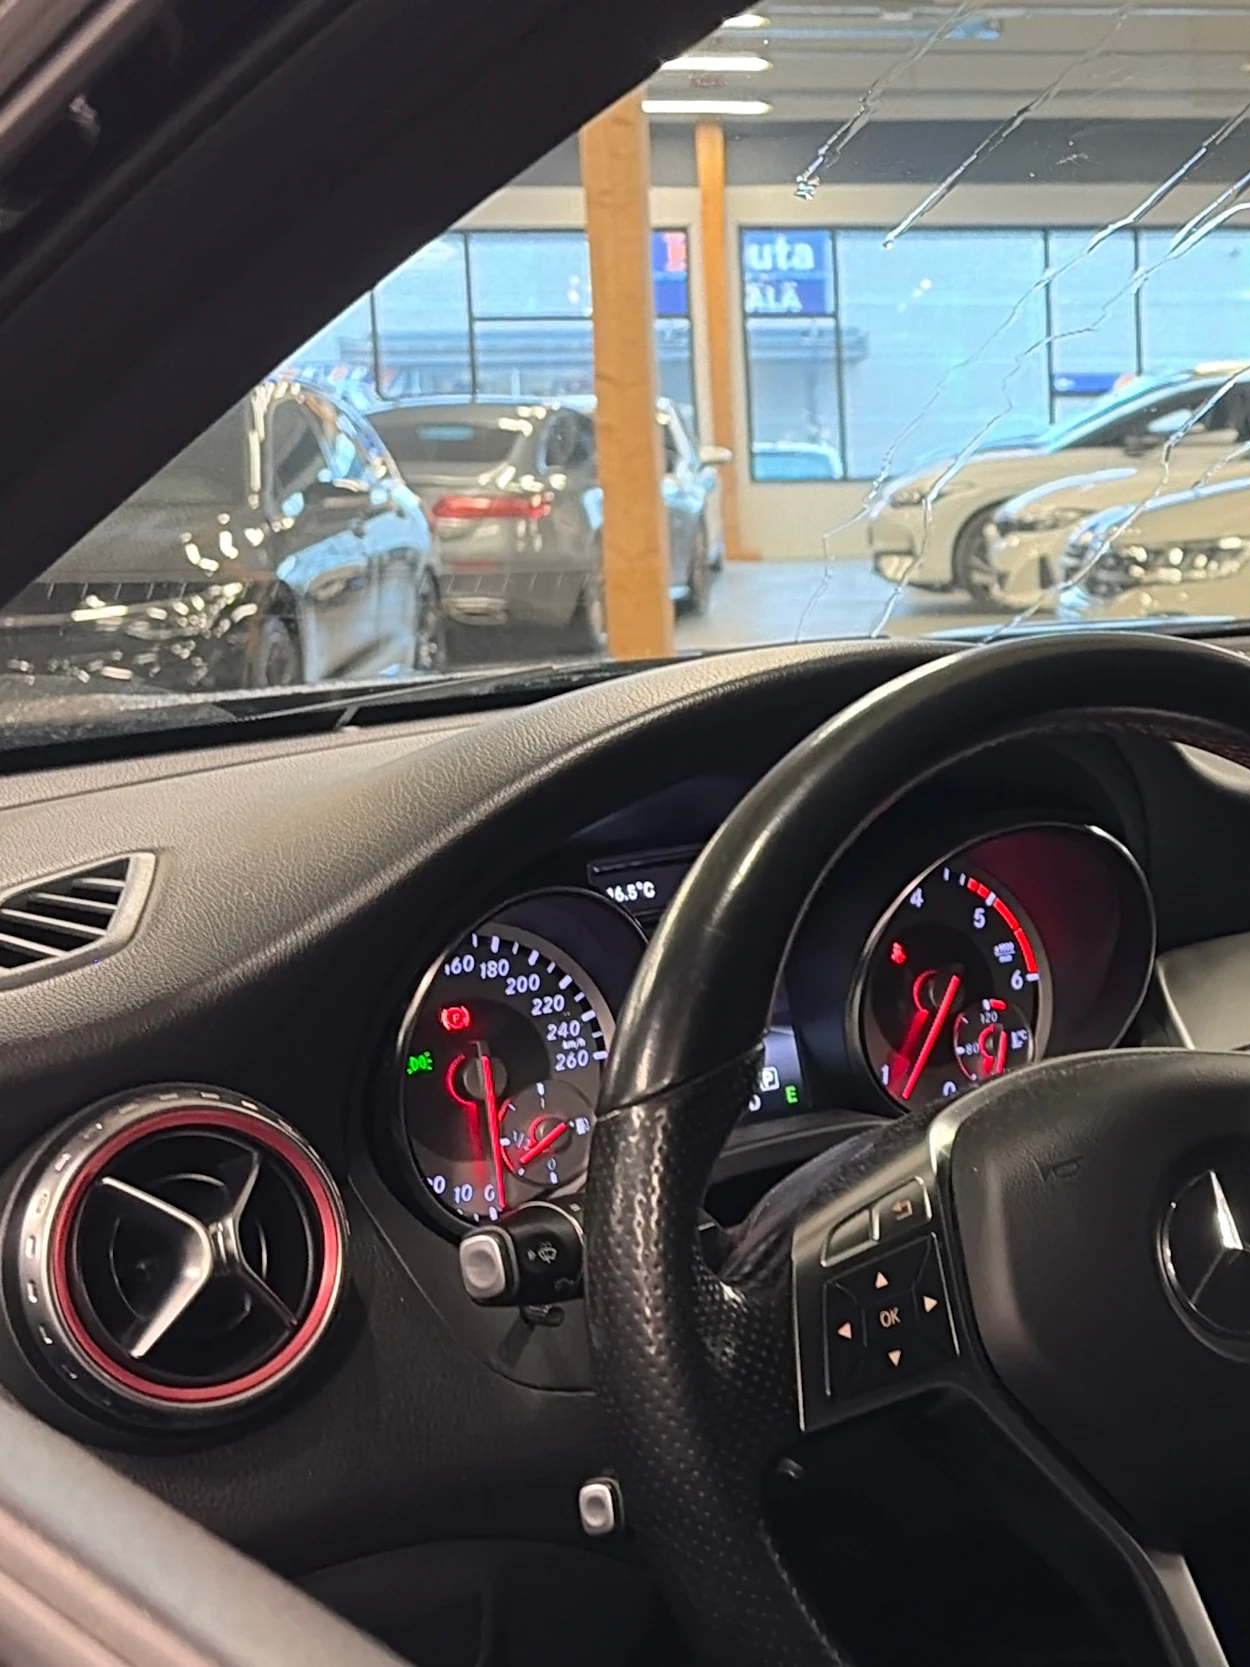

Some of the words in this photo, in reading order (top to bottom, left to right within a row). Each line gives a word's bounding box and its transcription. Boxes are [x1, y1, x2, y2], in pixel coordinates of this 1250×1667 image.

[910, 887, 925, 909] 4
[973, 907, 986, 930] 5
[480, 958, 510, 980] 180
[1011, 968, 1024, 991] 6
[505, 973, 541, 996] 200
[531, 994, 565, 1017] 220
[980, 1011, 999, 1025] 120
[546, 1019, 581, 1041] 240
[965, 1042, 979, 1056] 80
[555, 1049, 590, 1072] 260
[881, 1063, 889, 1086] 1
[784, 1085, 799, 1104] E
[454, 1183, 473, 1204] 10
[880, 1306, 901, 1328] OK
